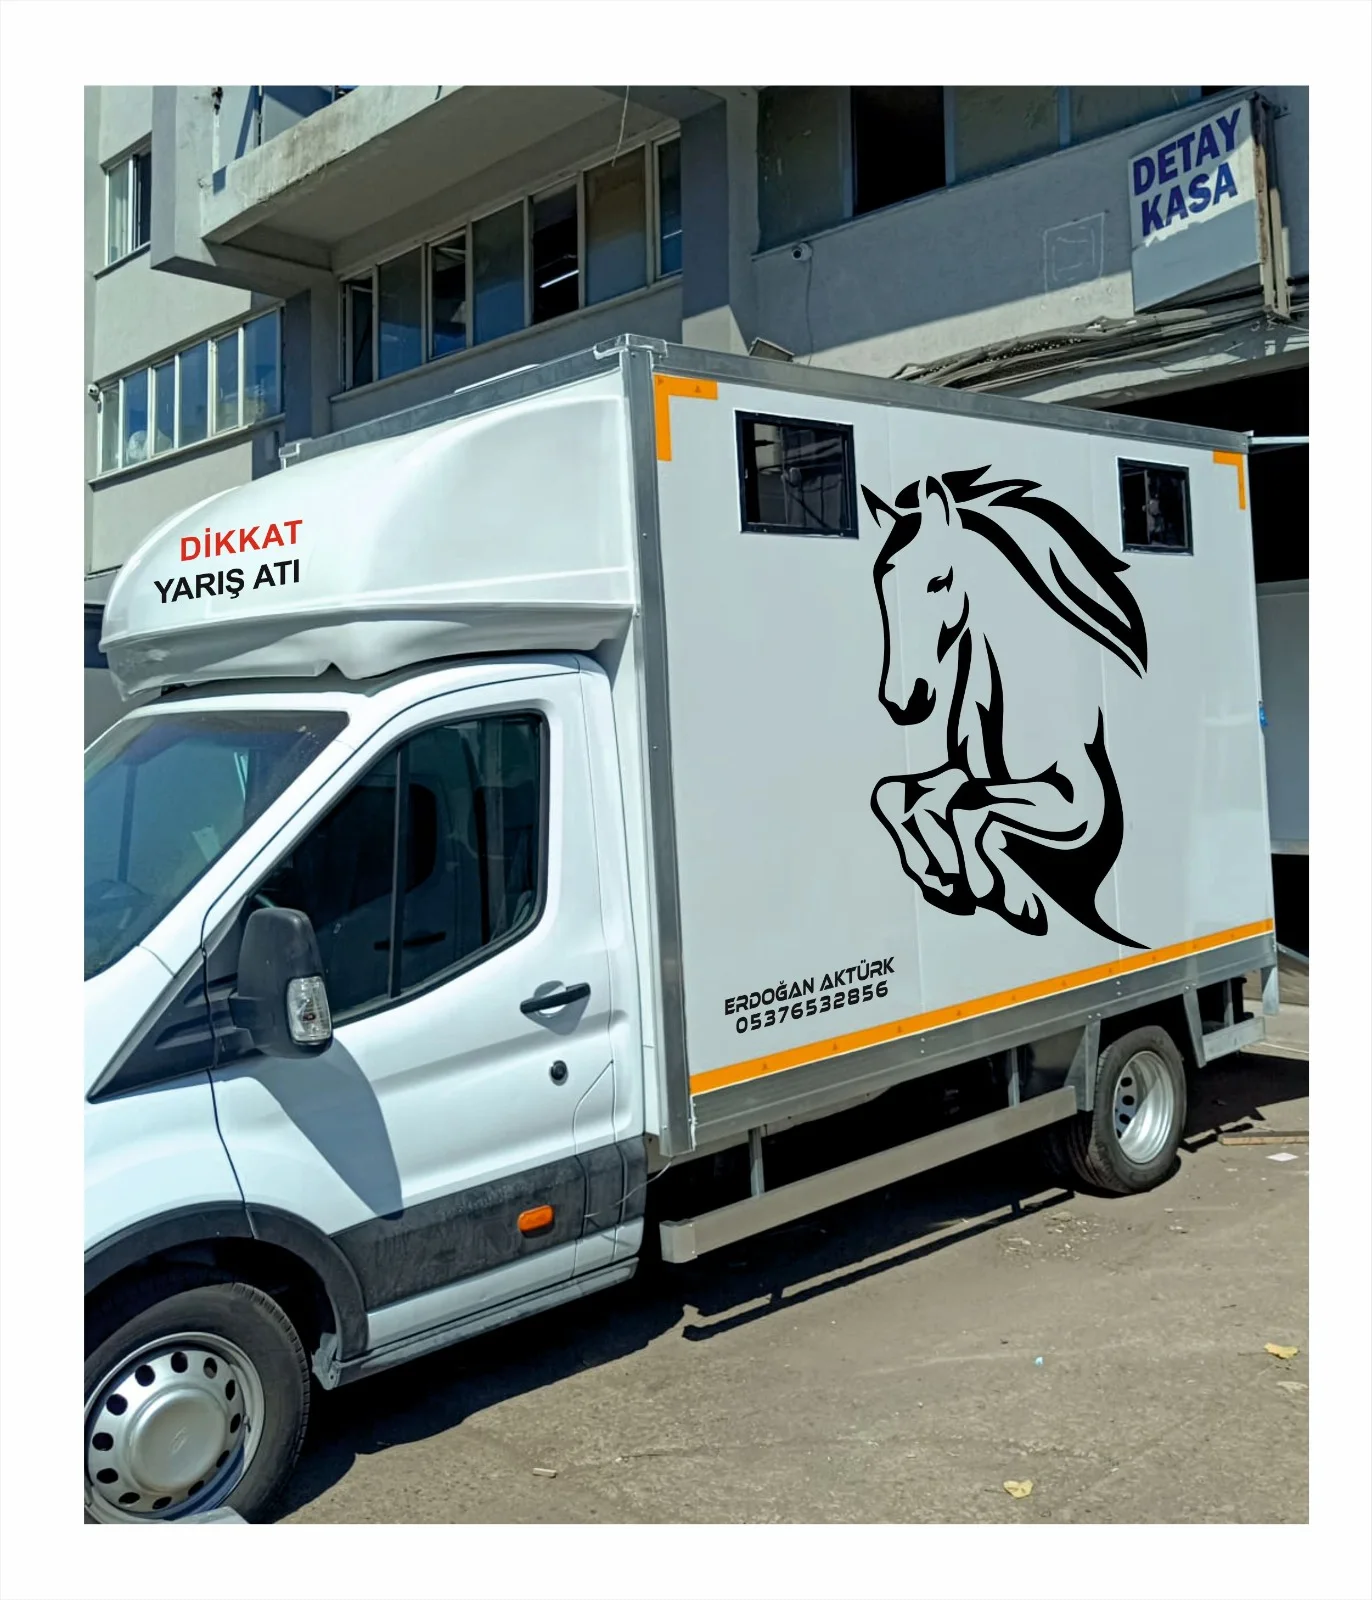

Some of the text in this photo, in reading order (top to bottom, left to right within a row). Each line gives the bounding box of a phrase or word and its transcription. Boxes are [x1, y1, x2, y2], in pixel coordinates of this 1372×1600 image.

[1133, 108, 1241, 196] DETAY
[1141, 162, 1238, 237] KASA
[180, 519, 303, 561] DİKKAT
[153, 558, 300, 604] YARIŞ ATI
[724, 956, 895, 1016] ERDOĞAN AKTÜRK
[735, 980, 889, 1034] 05376532856
